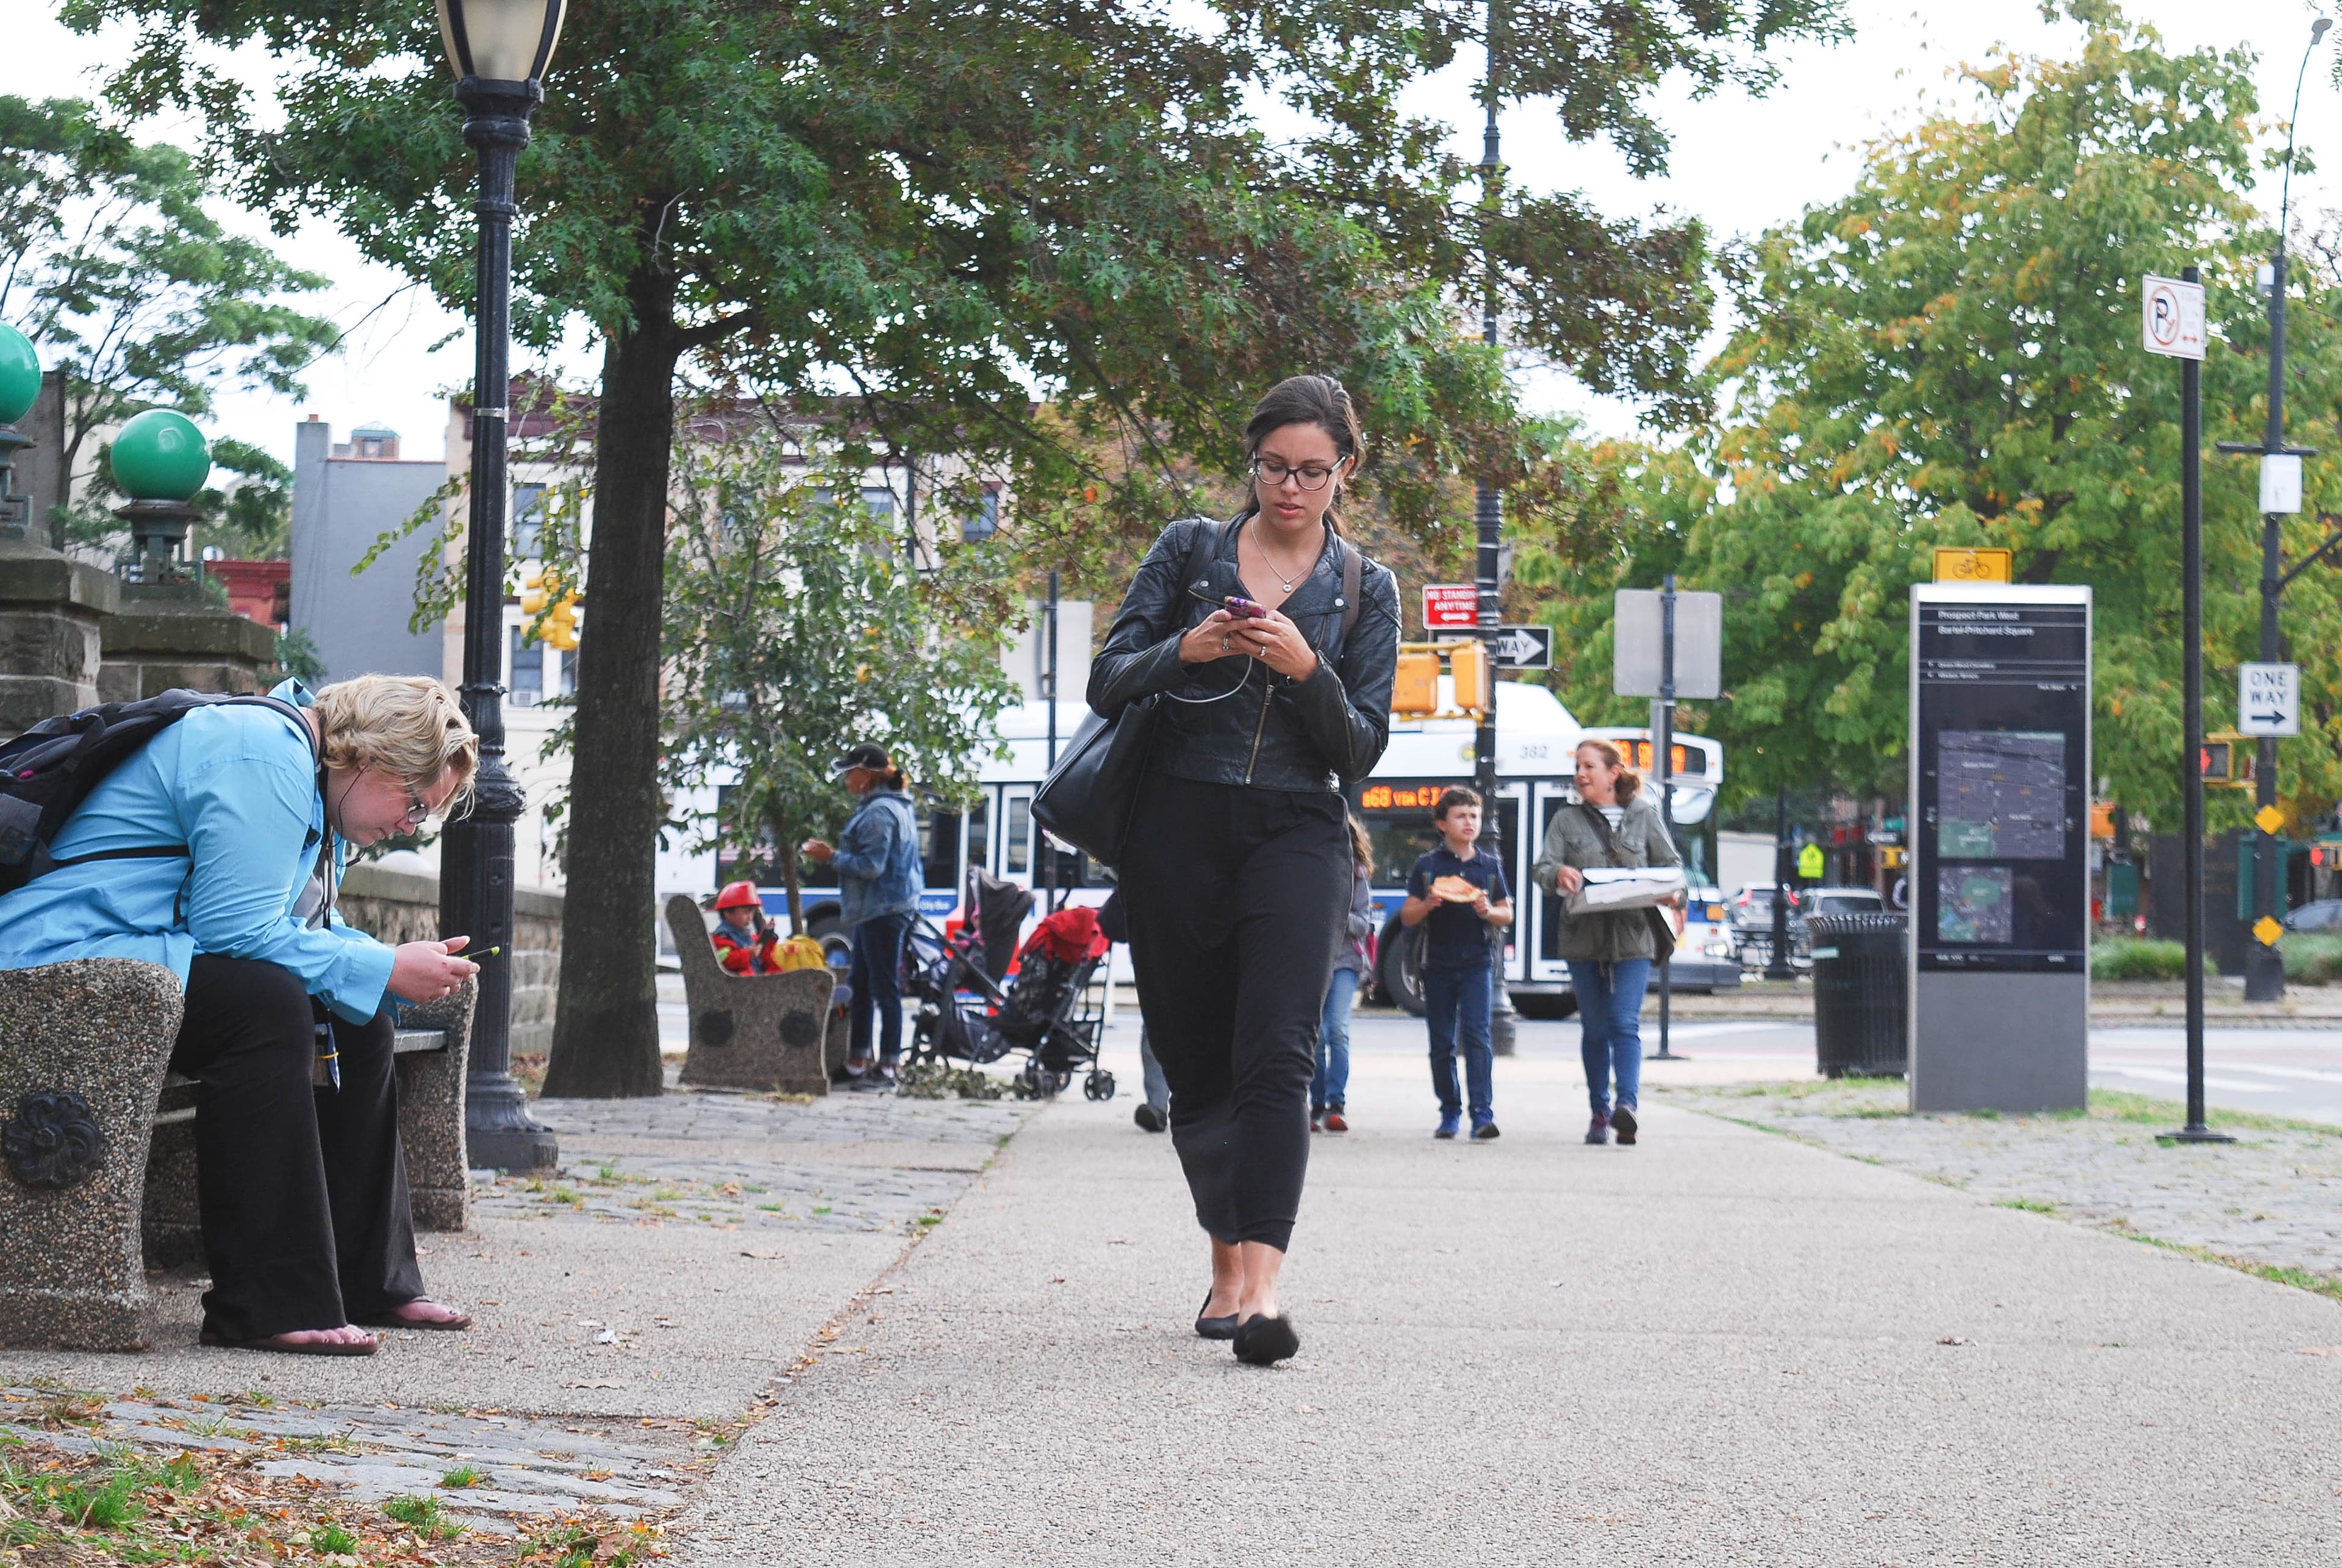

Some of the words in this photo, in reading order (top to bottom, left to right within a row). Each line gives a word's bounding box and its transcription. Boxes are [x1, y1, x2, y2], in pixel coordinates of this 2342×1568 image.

[1427, 590, 1441, 600] NO
[1442, 590, 1476, 600] STANDIN
[1434, 601, 1477, 610] ANYTIME
[1938, 610, 1977, 621] Prospect
[1977, 610, 1997, 620] Park
[1997, 610, 2020, 620] West
[2003, 626, 2035, 637] Square
[1497, 640, 1530, 652] WAY
[2251, 671, 2288, 687] ONE
[2249, 690, 2288, 706] WAY
